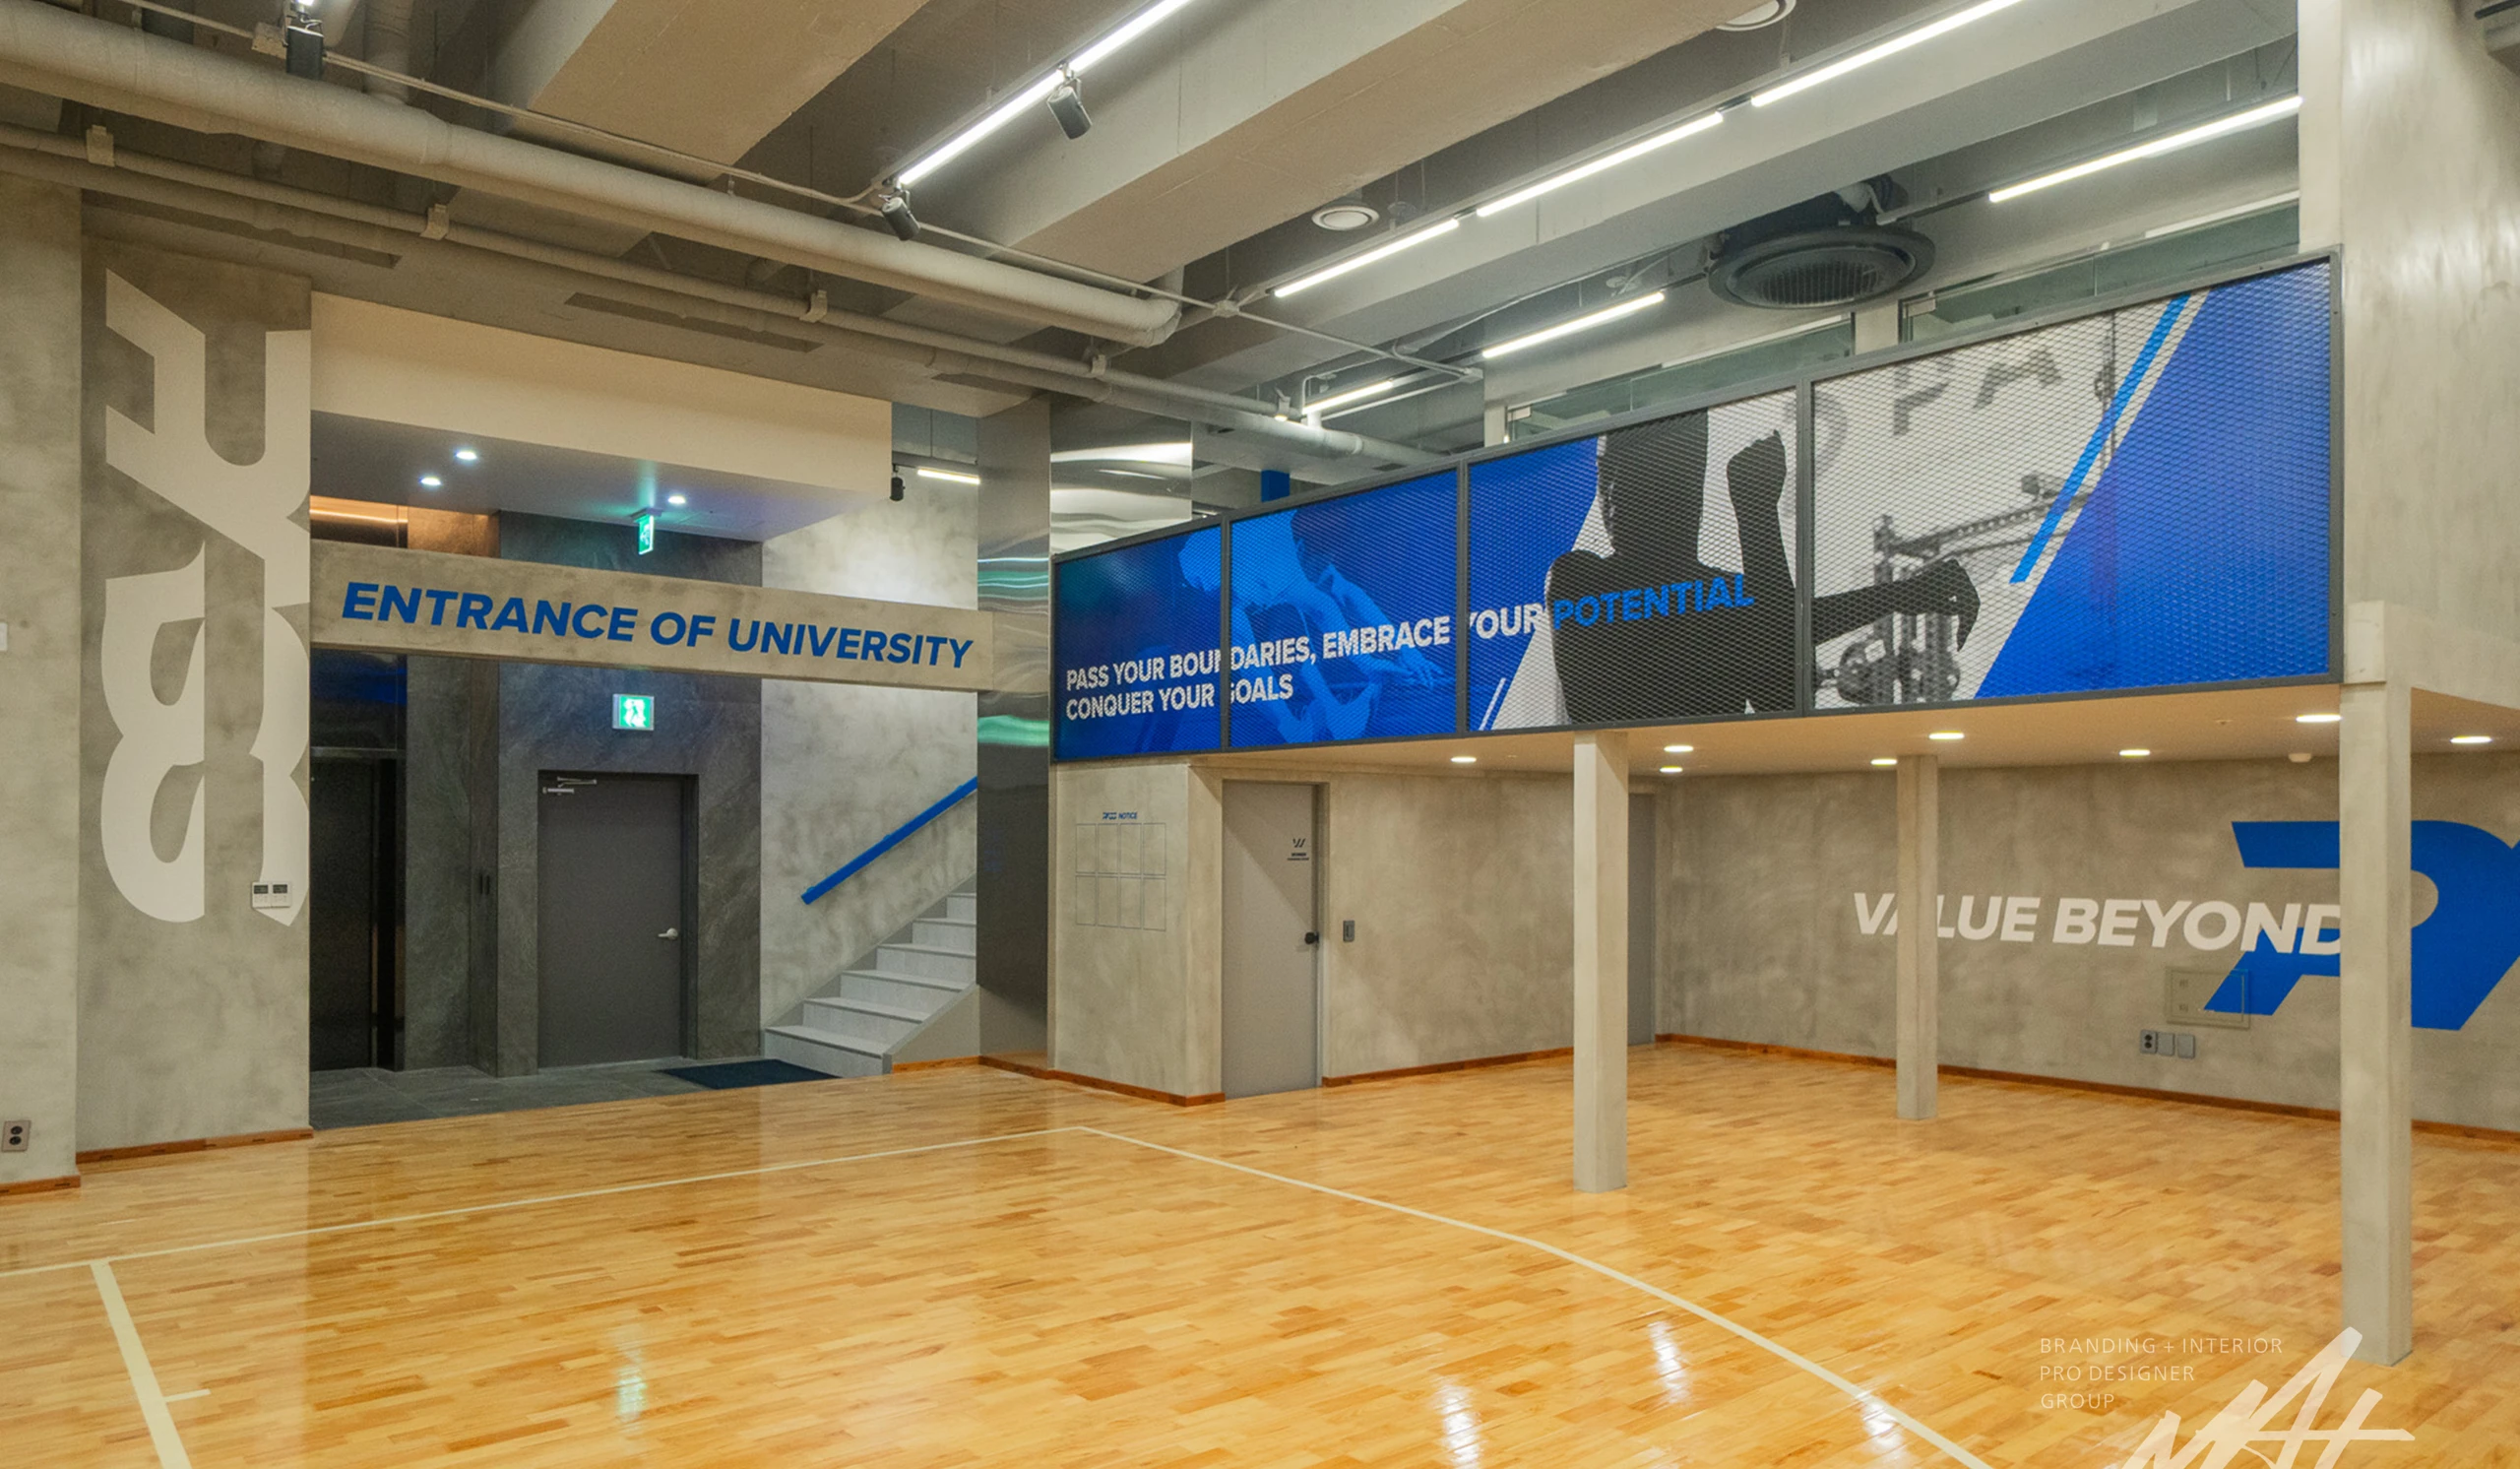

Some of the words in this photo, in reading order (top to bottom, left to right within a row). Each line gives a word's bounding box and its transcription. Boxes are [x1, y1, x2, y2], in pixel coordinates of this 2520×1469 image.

[342, 581, 639, 642] ENTRANCE
[651, 610, 717, 648] OF
[727, 618, 975, 670] UNIVERSITY
[1066, 665, 1109, 691] PASS
[1112, 658, 1165, 684] YOUR
[1323, 616, 1450, 659] EMBRACE
[1552, 574, 1755, 630] POTENTIAL
[1066, 690, 1154, 721] CONQUER
[1158, 683, 1215, 710] YOUR
[1230, 673, 1293, 704] OALS
[1854, 892, 2041, 941] VLUE
[2052, 897, 2341, 956] BEYOND
